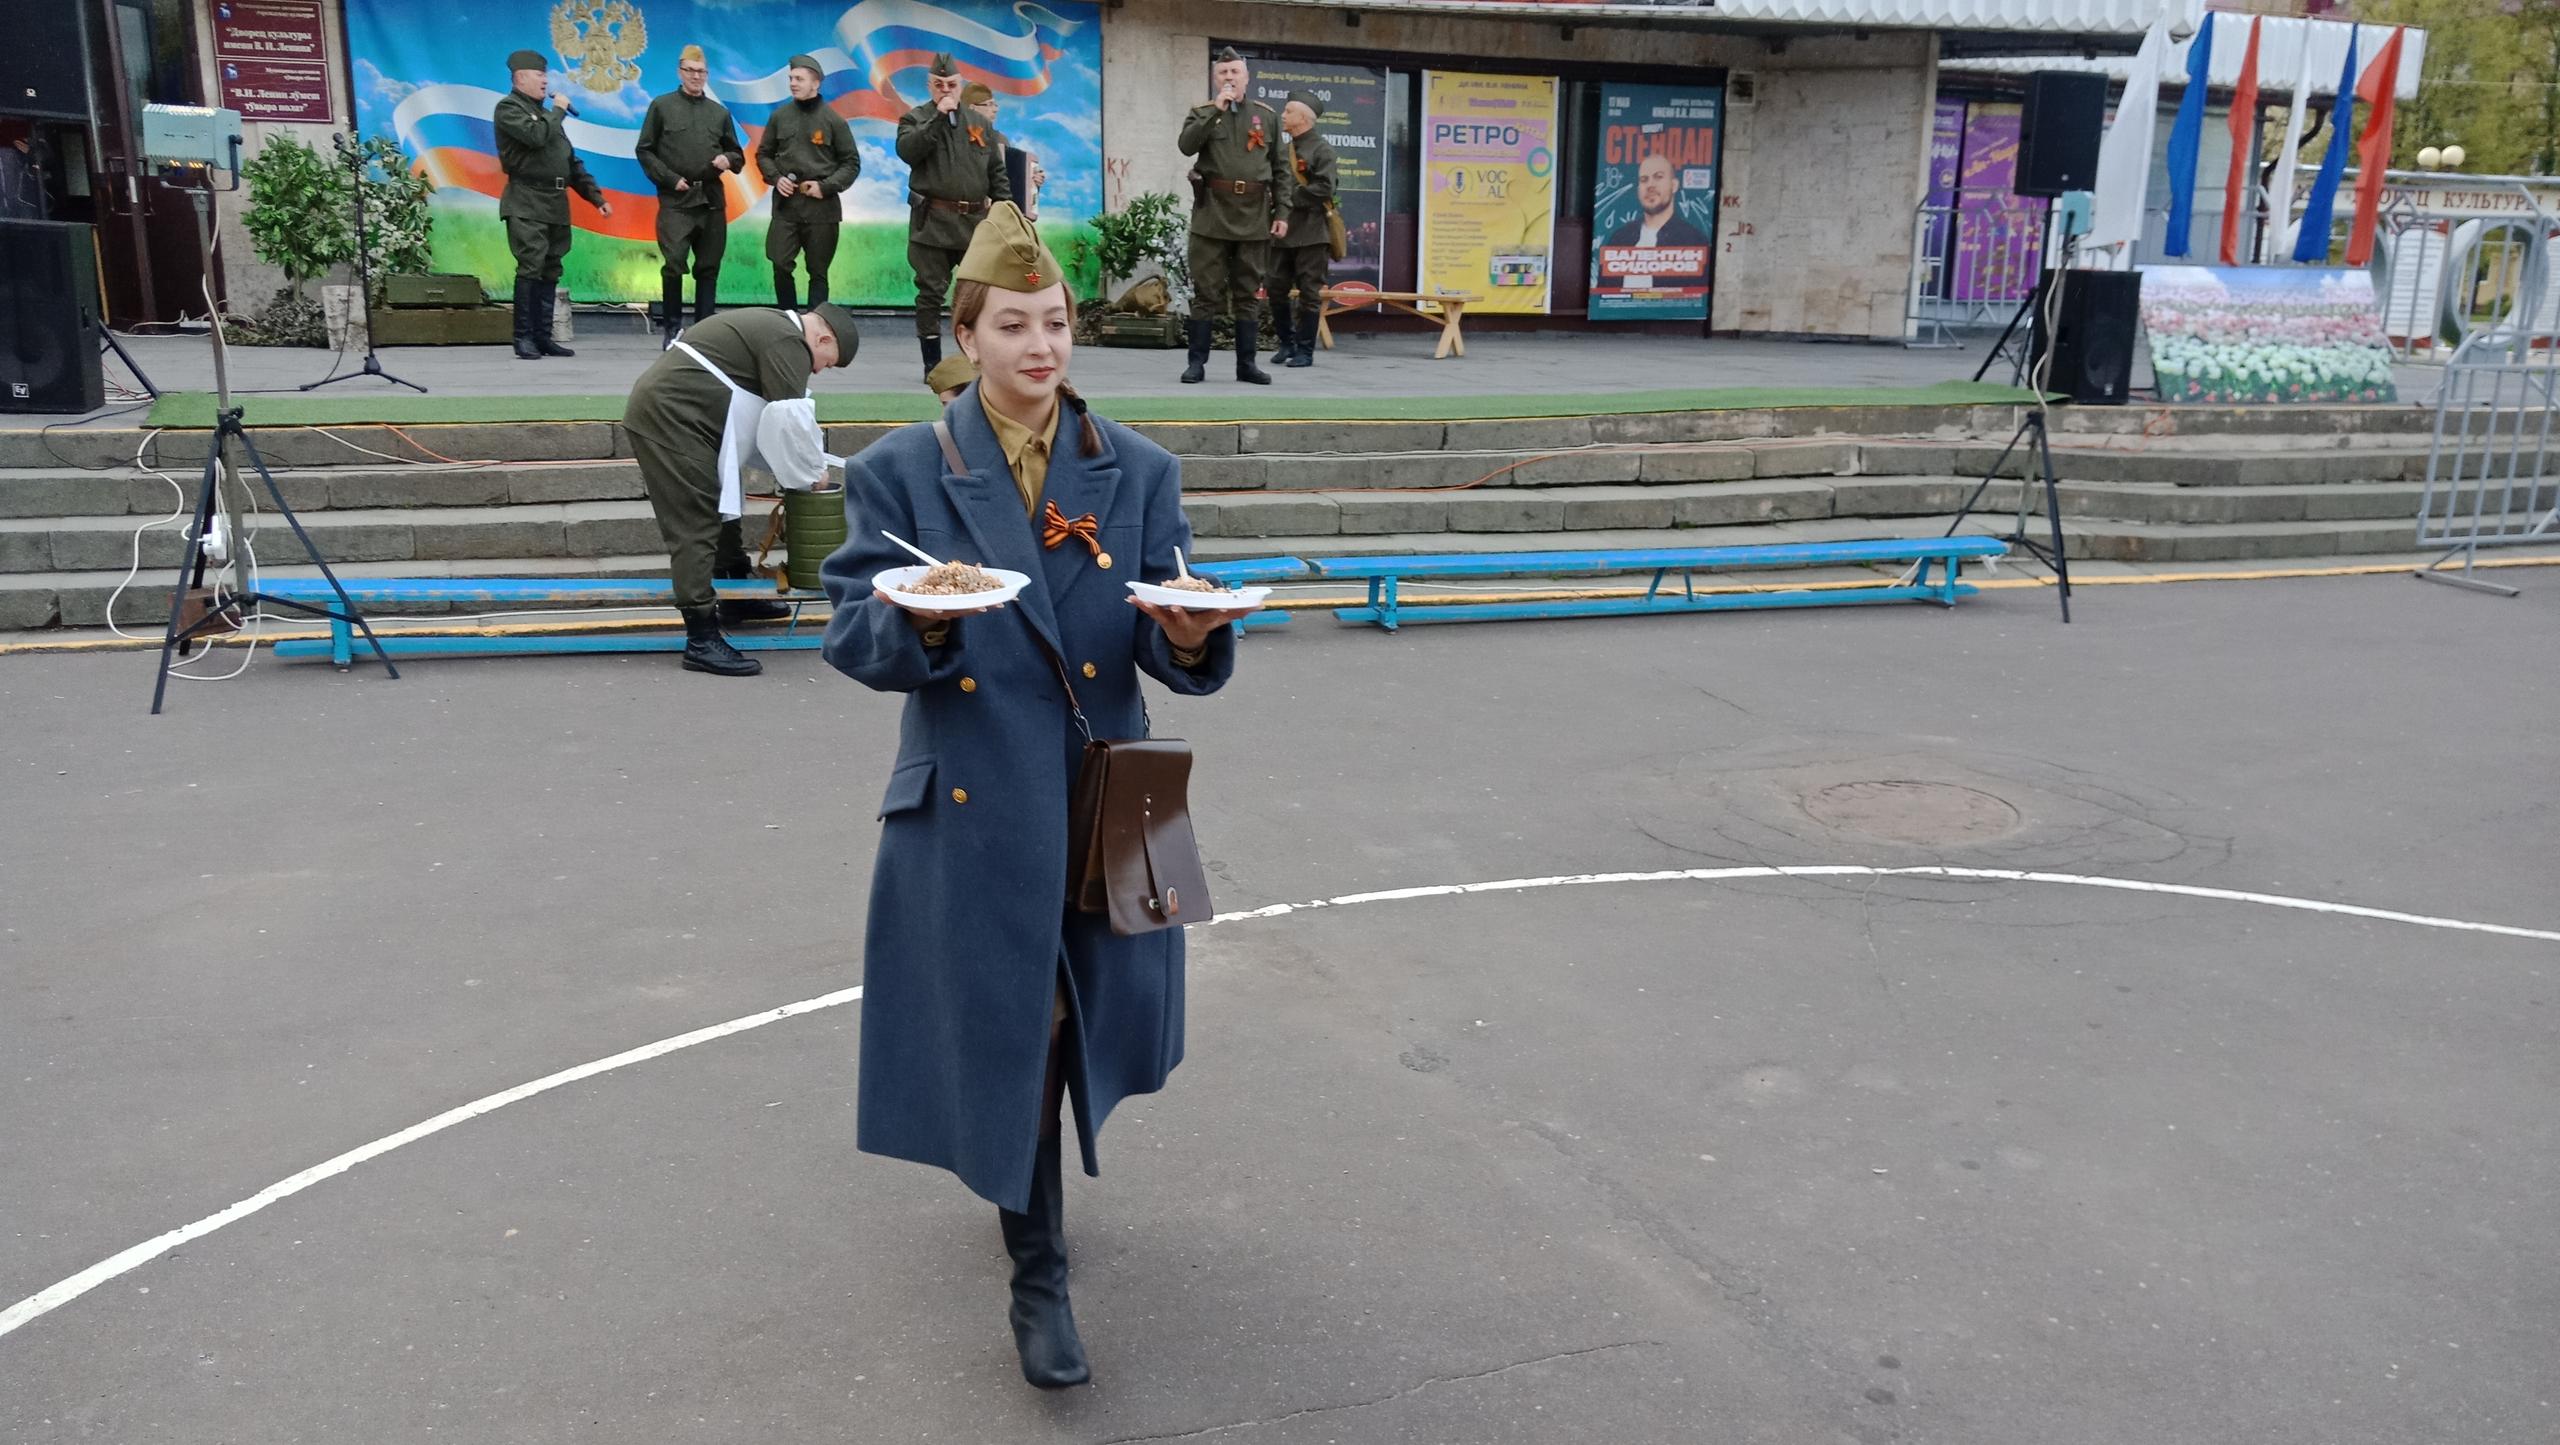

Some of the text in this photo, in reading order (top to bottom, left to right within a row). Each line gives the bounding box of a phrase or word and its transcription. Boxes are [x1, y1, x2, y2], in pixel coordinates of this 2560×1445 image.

[1258, 86, 1267, 98] 9
[1435, 124, 1520, 146] РЕТРО
[1605, 124, 1714, 171] СТЕНДАП
[1604, 249, 1704, 261] ВАЛЕНТИН
[1607, 261, 1699, 274] СИДОРОВ
